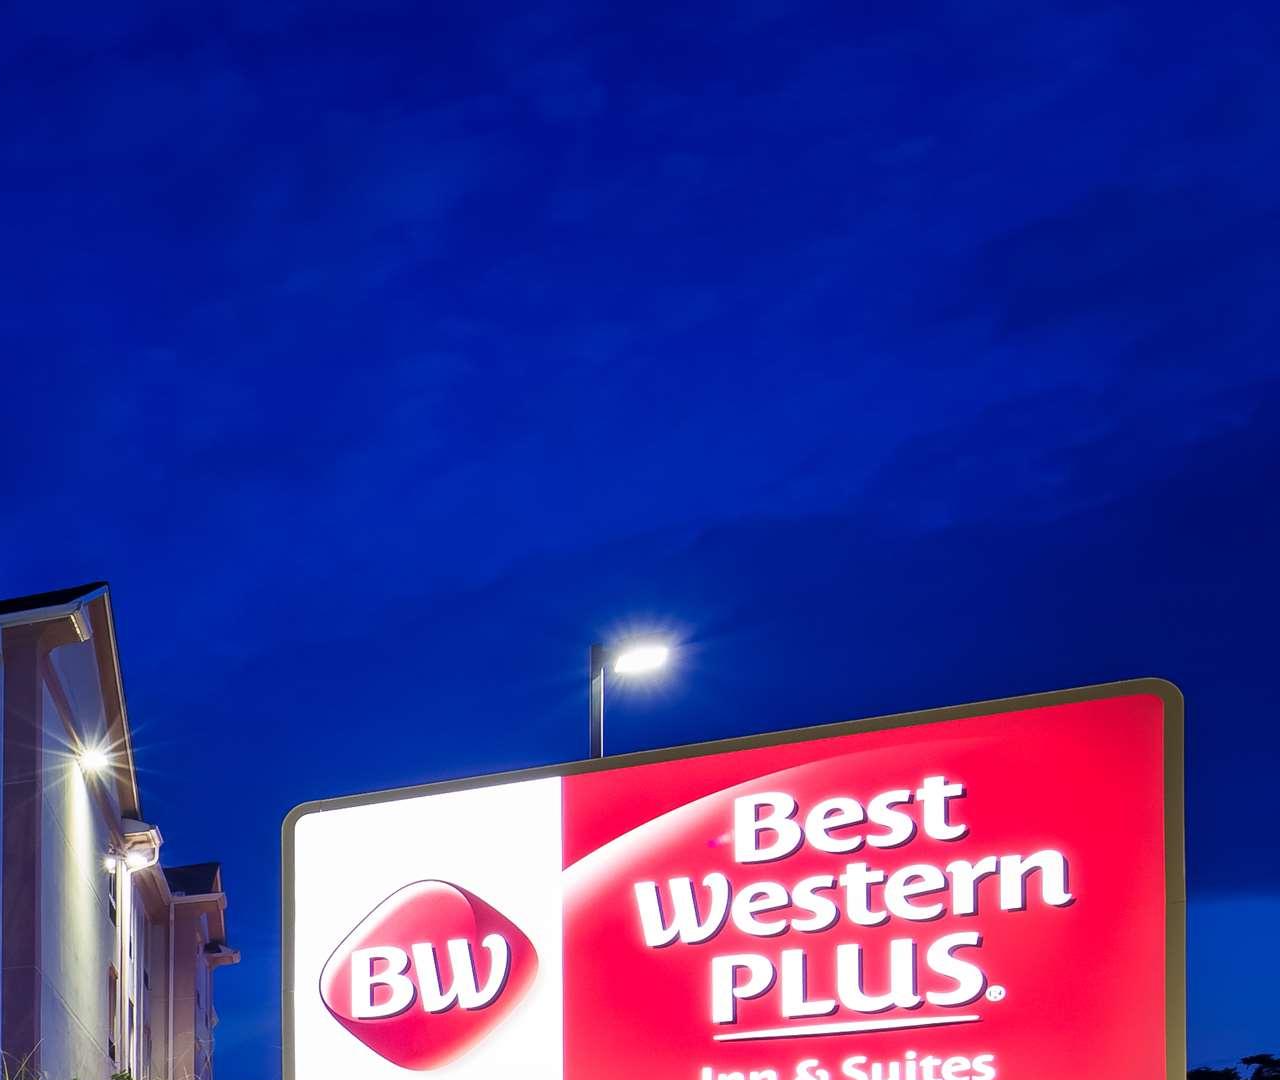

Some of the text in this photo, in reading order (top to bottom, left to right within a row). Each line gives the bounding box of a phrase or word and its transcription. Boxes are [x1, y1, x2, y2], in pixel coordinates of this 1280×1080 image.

[734, 776, 969, 864] Best
[634, 849, 1076, 948] Western
[351, 933, 512, 1020] BW
